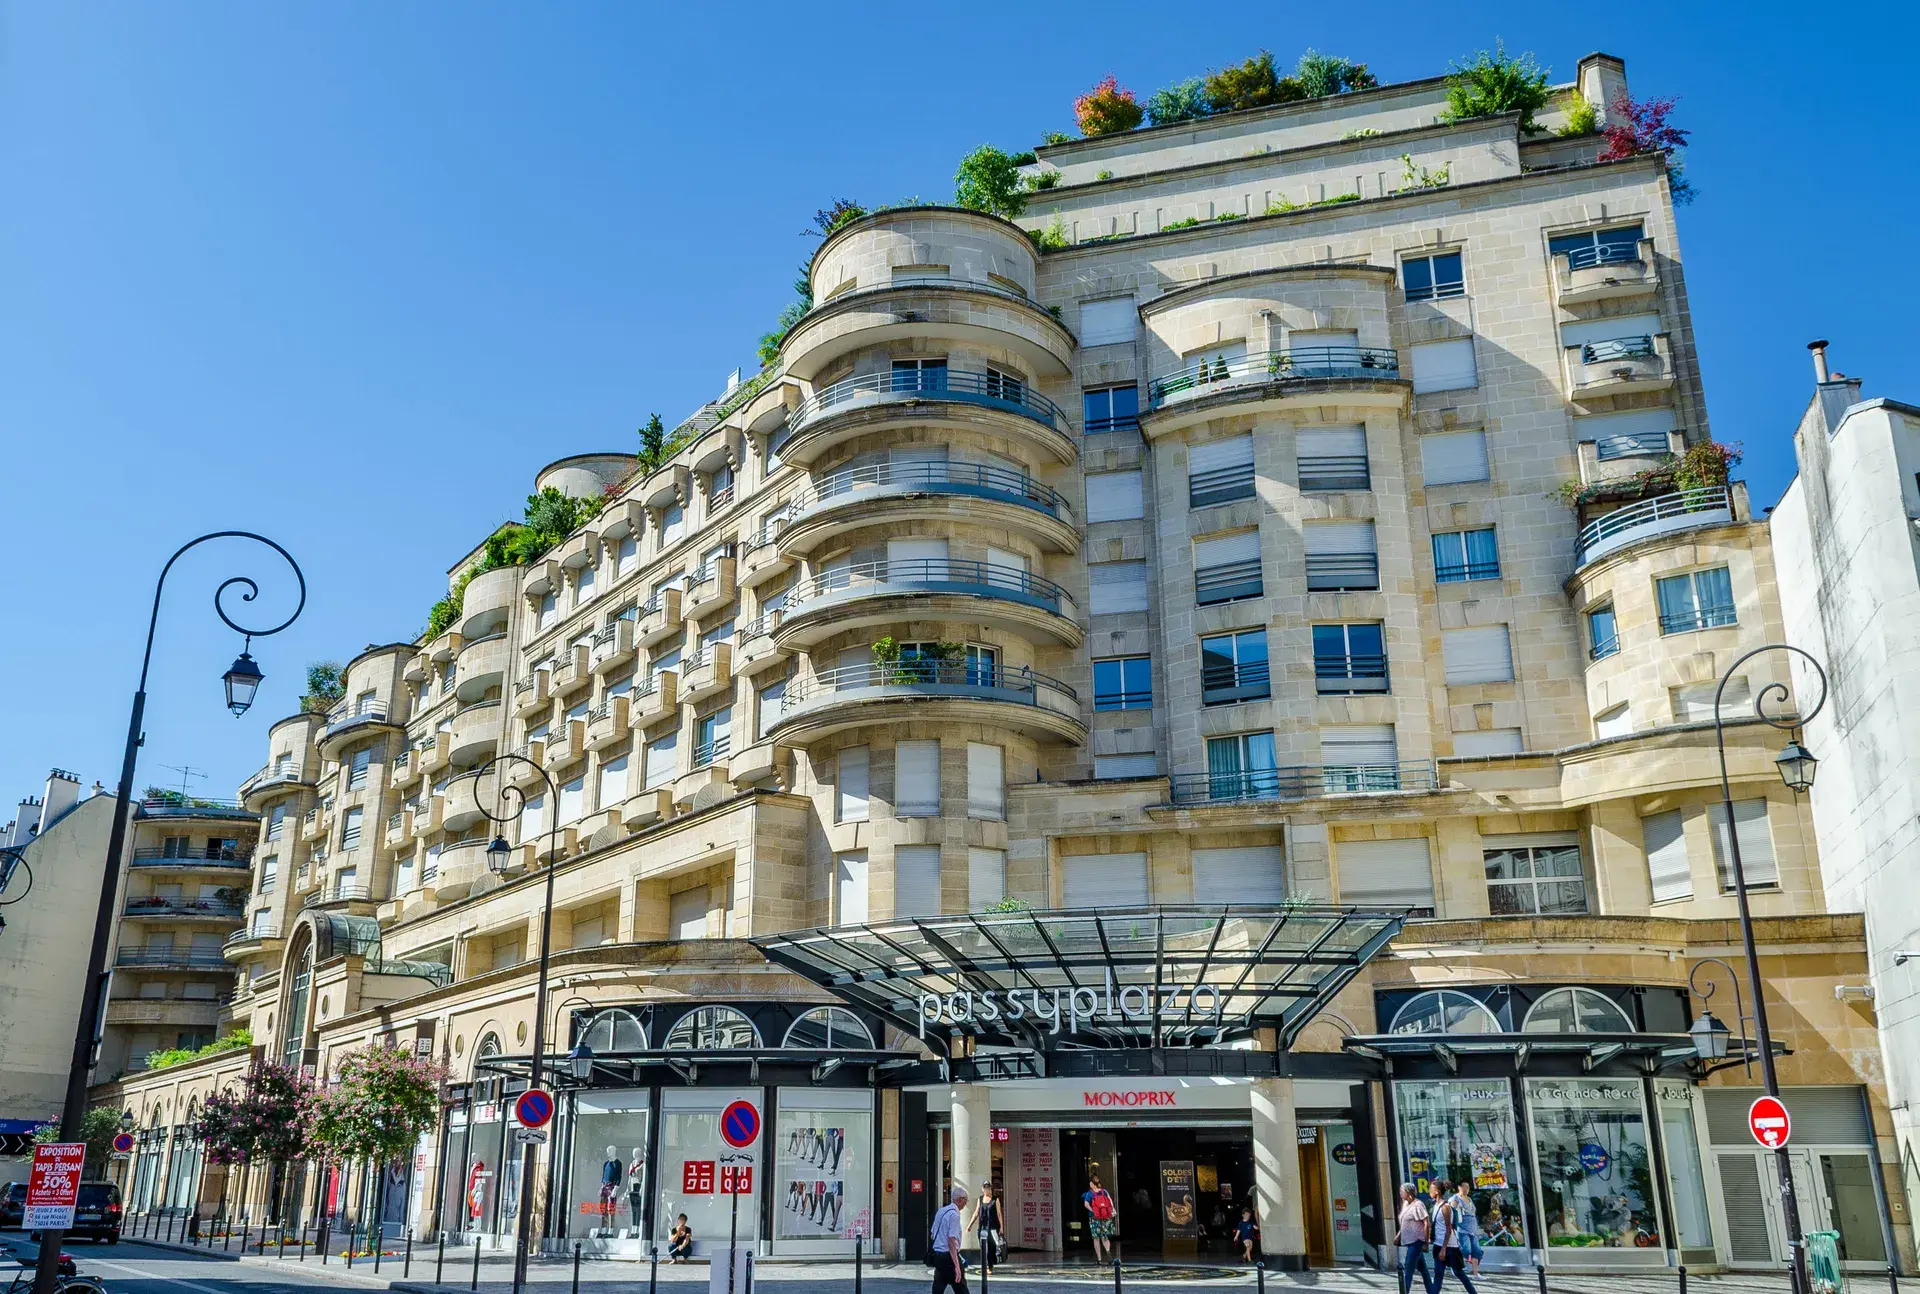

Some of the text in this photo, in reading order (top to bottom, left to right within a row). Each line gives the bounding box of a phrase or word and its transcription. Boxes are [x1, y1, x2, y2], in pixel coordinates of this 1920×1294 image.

[919, 966, 1220, 1040] passyplaza
[1083, 1091, 1176, 1106] MONOPRIX
[1463, 1088, 1495, 1101] Jeux
[1552, 1088, 1601, 1100] Grande
[40, 1147, 82, 1156] EXPOSITION
[35, 1162, 82, 1171] TAPIS PERSAN
[687, 1165, 711, 1176] ユニ
[37, 1176, 72, 1189] -50%
[686, 1178, 711, 1190] クロ
